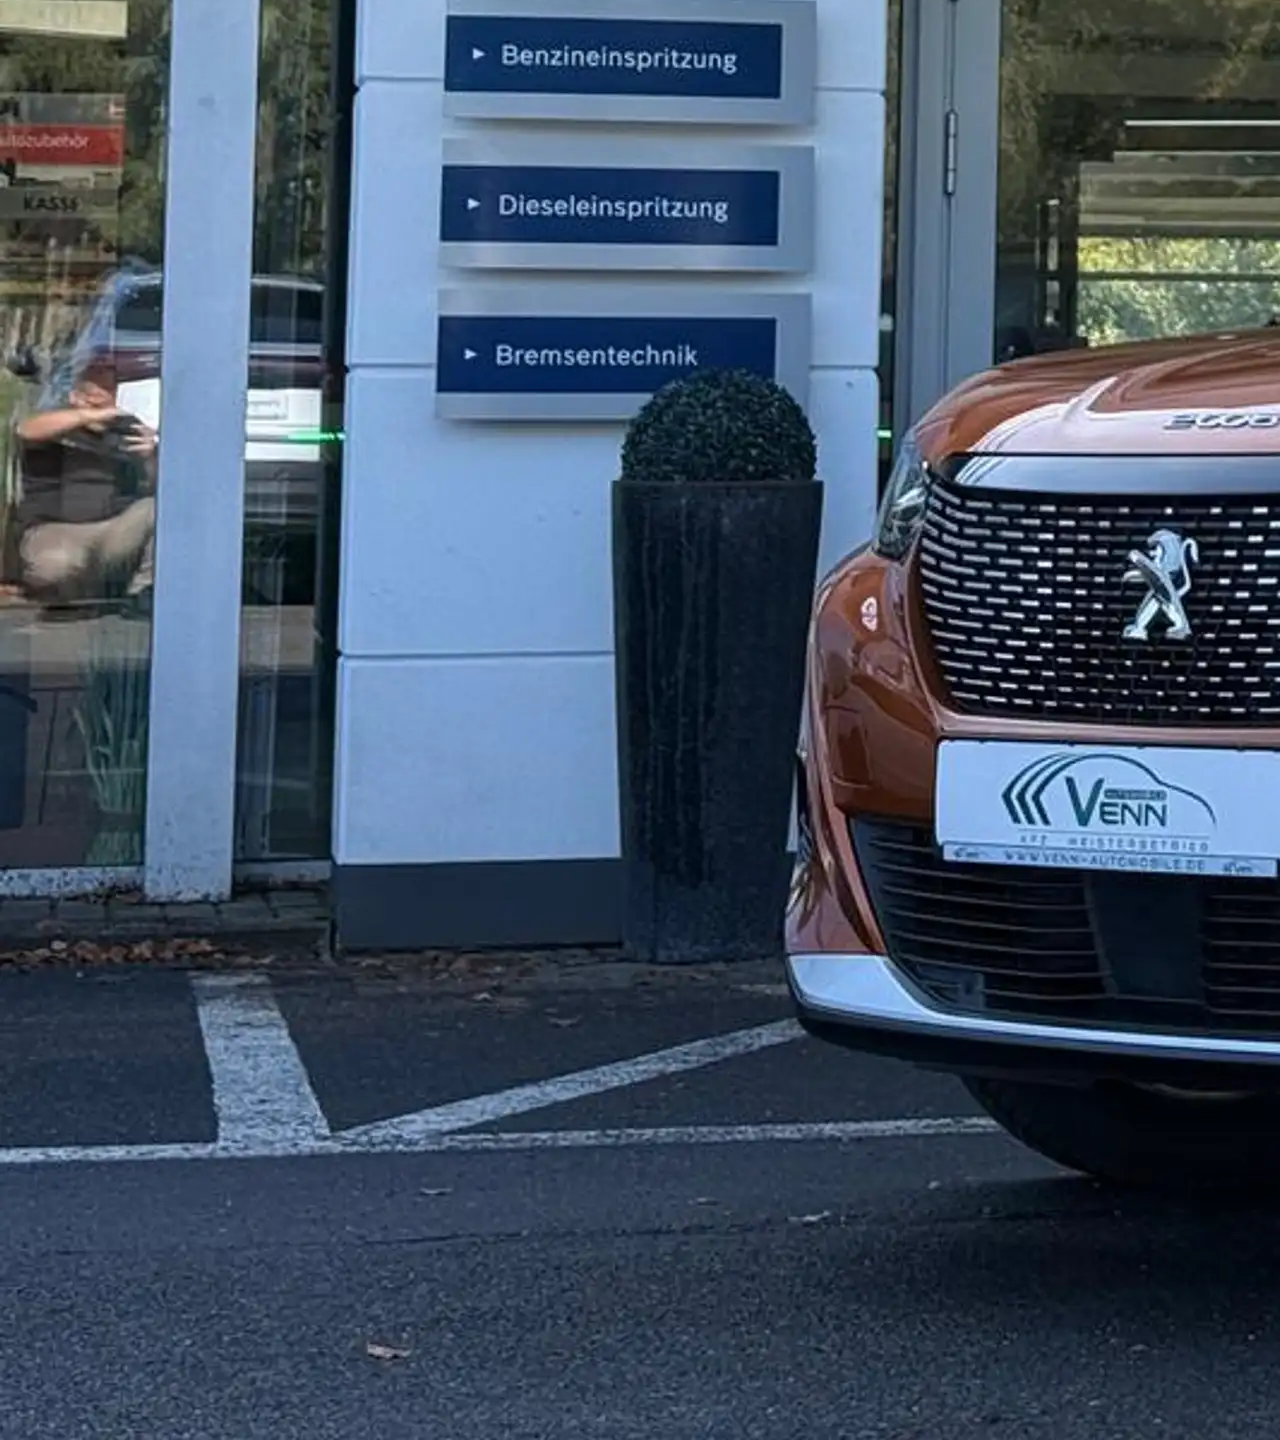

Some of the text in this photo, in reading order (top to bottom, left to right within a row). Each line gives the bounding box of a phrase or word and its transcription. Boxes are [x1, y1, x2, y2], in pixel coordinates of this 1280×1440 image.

[501, 43, 738, 75] Benzineinspritzung
[498, 193, 729, 223] Dieseleinspritzung
[495, 344, 699, 367] Bremsentechnik
